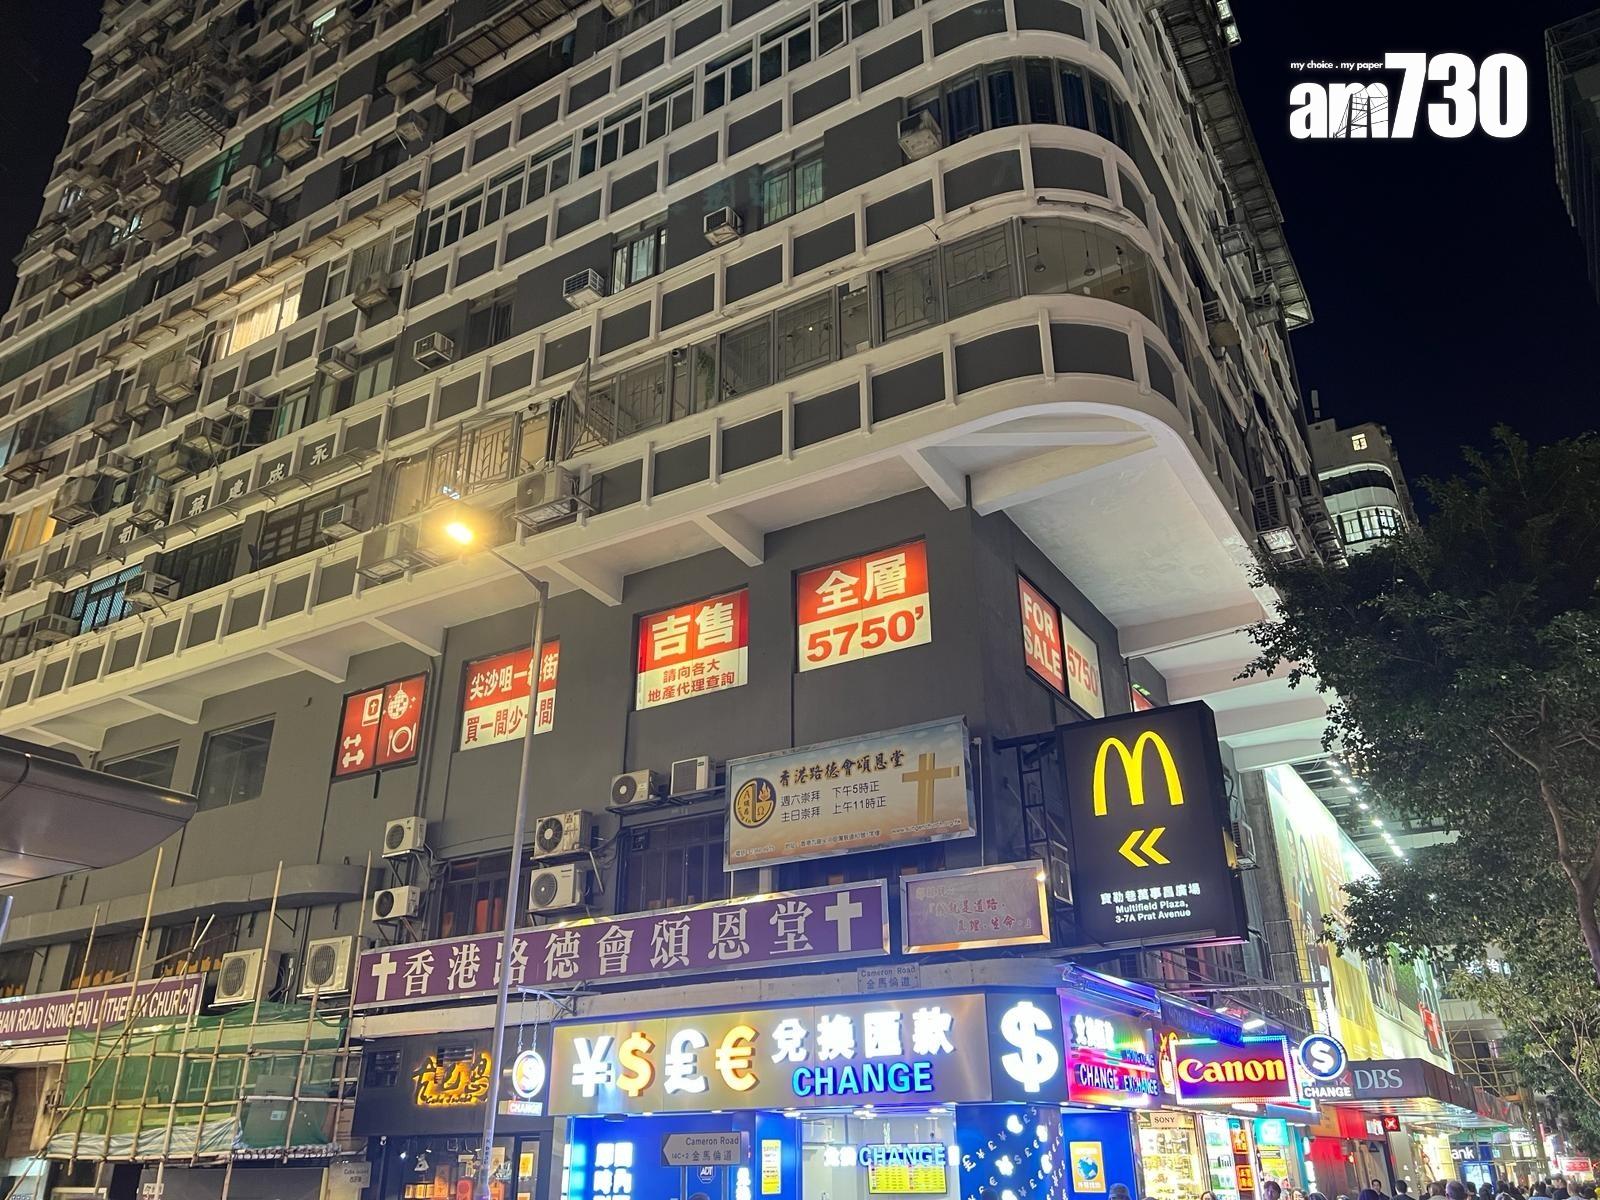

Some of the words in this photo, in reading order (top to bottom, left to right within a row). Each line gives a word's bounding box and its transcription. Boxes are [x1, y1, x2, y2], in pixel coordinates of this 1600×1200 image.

[815, 552, 908, 615] 全層
[651, 601, 734, 661] 吉售
[1023, 592, 1055, 643] FOR
[1024, 624, 1062, 681] SALE
[663, 658, 720, 684] 請向各大
[648, 671, 735, 703] 地產代理查詢
[464, 697, 554, 745] 買一間少間
[780, 749, 905, 788] 香港路德會頌恩堂
[781, 790, 821, 807] 週六崇拜
[832, 780, 880, 798] 下午5時正
[781, 806, 821, 823] 主日崇拜
[832, 796, 888, 815] 上午11時正
[1115, 902, 1158, 914] Multifield
[1160, 900, 1189, 910] Plaza,
[1115, 914, 1136, 924] 3-7A
[1137, 912, 1157, 921] Prat
[1158, 909, 1191, 920] Avenue
[402, 900, 814, 997] 香港路德會頌恩堂
[861, 969, 893, 978] Cameron
[15, 1006, 44, 1033] ROAD
[43, 998, 94, 1033] (SUNGEN)
[791, 1060, 934, 1097] CHANGE
[1079, 1064, 1119, 1090] CHANGE
[1123, 1074, 1158, 1096] EXCHANGE
[1177, 1057, 1287, 1084] Canon
[1354, 1069, 1404, 1090] DBS
[1304, 1086, 1352, 1098] CHANGE
[1154, 1116, 1175, 1124] SONY
[685, 1137, 718, 1146] Cameron
[720, 1136, 739, 1145] Road
[692, 1150, 732, 1161] 金馬倫道
[858, 1145, 946, 1167] CHANGE
[700, 1166, 713, 1176] ADT
